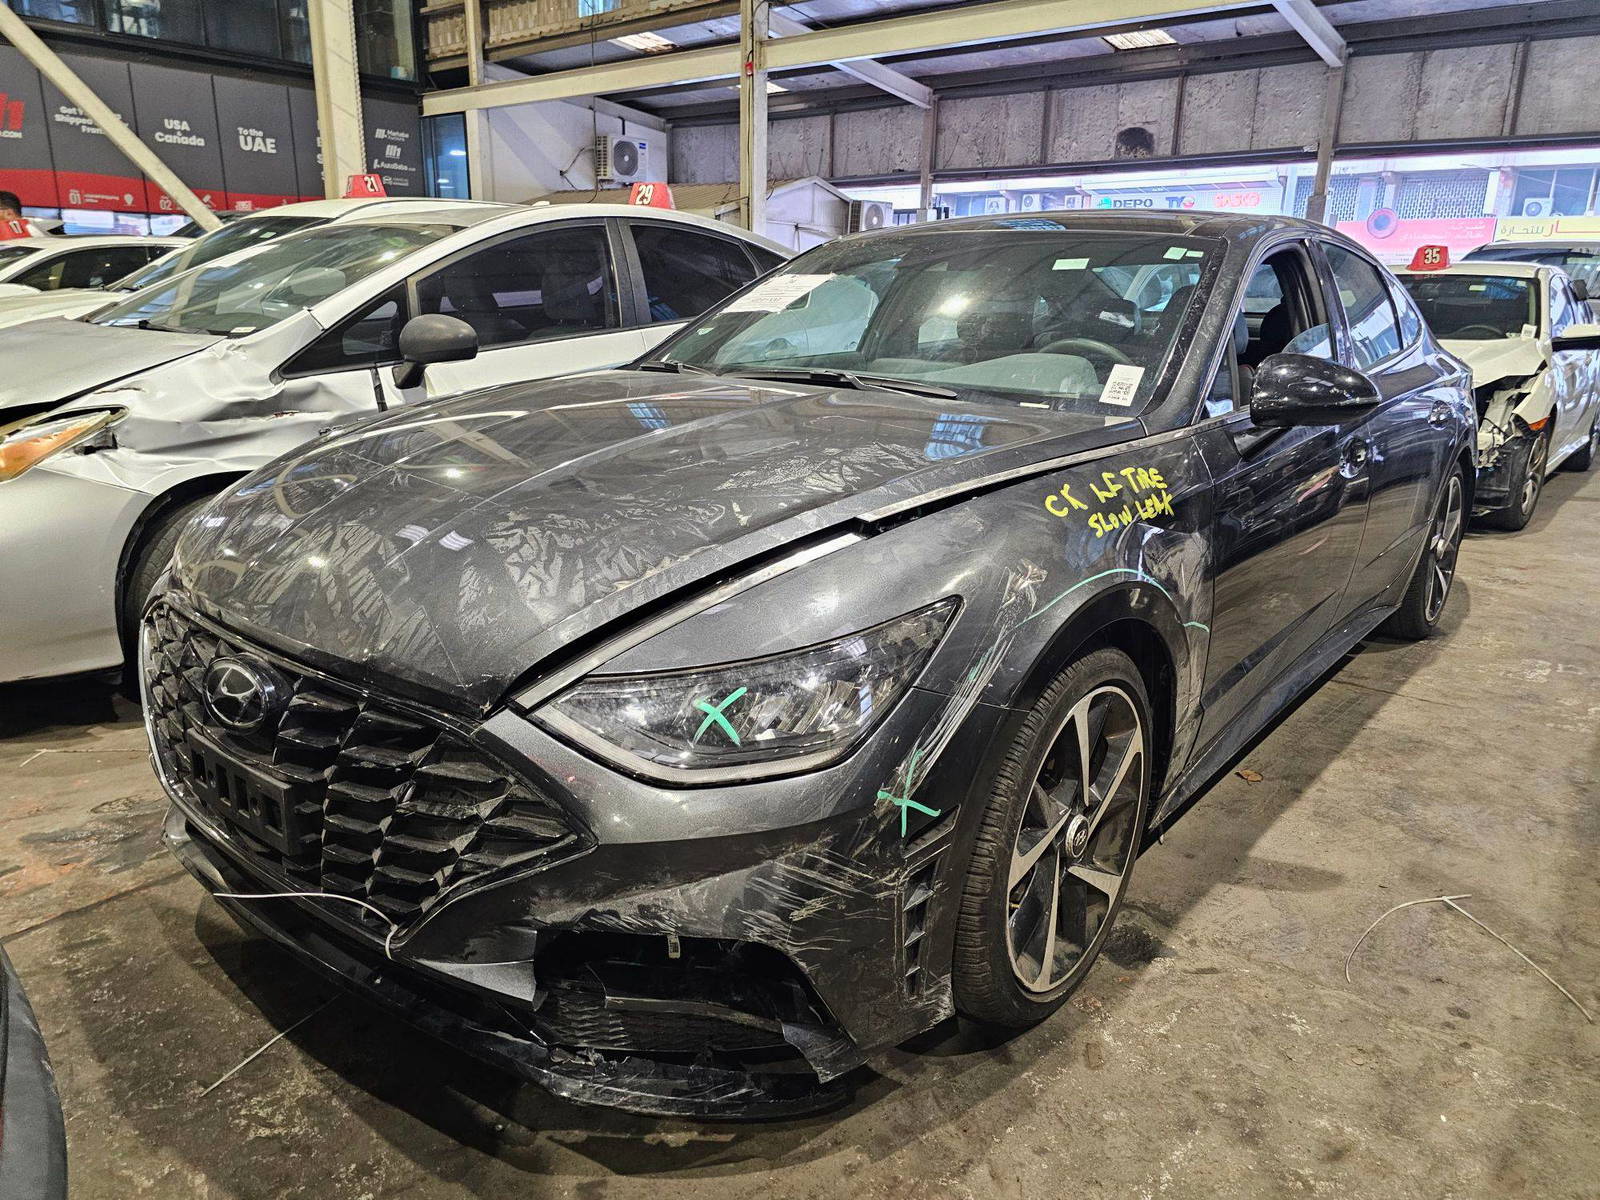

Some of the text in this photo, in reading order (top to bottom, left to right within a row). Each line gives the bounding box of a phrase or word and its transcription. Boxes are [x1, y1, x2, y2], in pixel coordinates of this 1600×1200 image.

[164, 119, 190, 131] USA
[237, 127, 263, 137] To the
[154, 132, 205, 146] Canada
[239, 135, 277, 153] UAE
[364, 176, 379, 192] 21
[635, 185, 654, 205] 29
[1113, 198, 1153, 208] DEPO
[1424, 248, 1441, 264] 35
[1045, 483, 1088, 517] CK
[1088, 504, 1132, 538] SLOW
